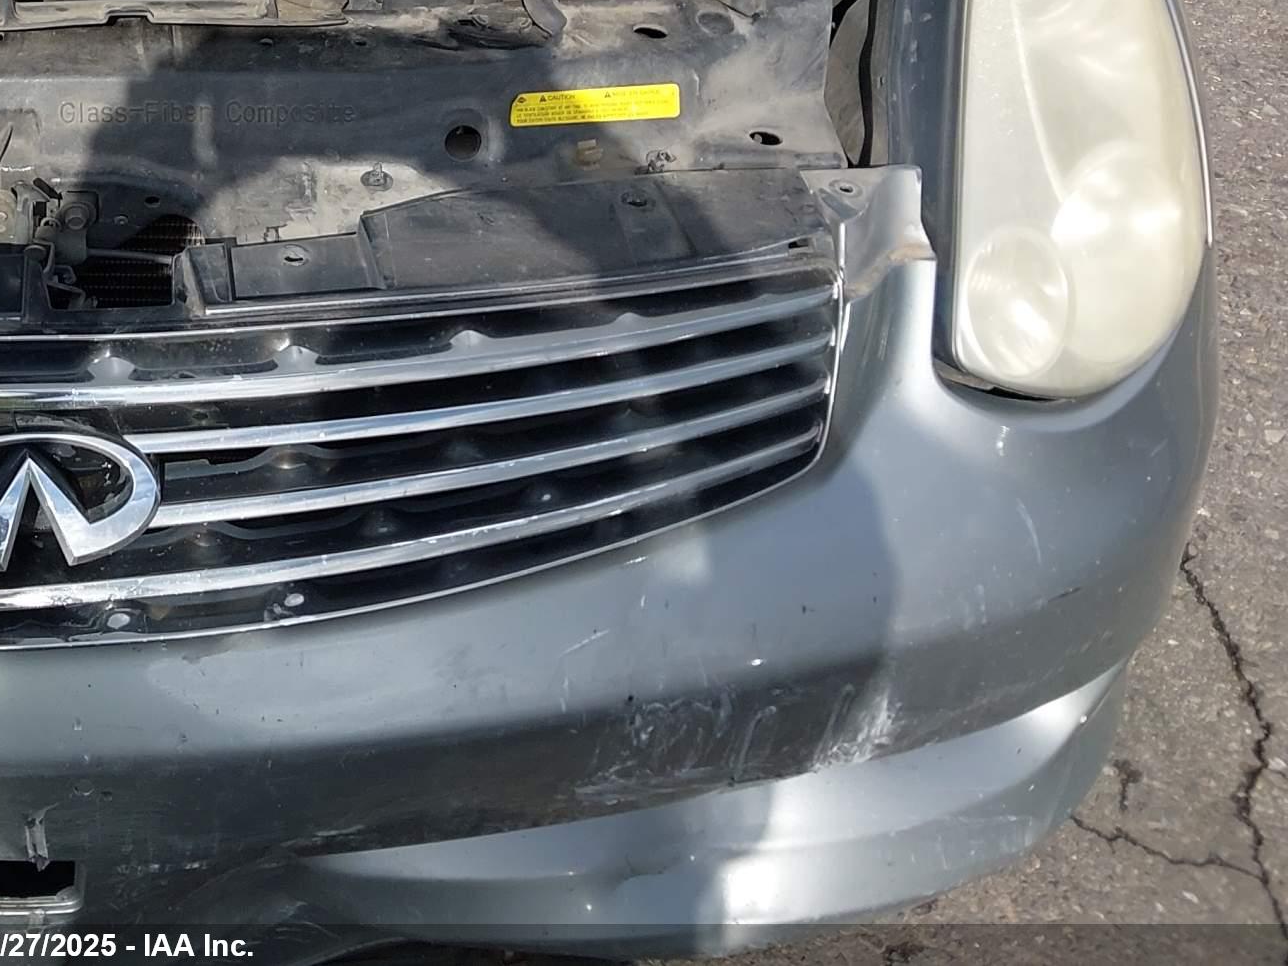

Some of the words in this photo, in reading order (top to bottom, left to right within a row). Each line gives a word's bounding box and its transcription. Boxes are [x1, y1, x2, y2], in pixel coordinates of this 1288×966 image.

[547, 94, 576, 102] CAUTION
[58, 101, 211, 124] Glass-Fiber
[225, 100, 356, 127] Composite
